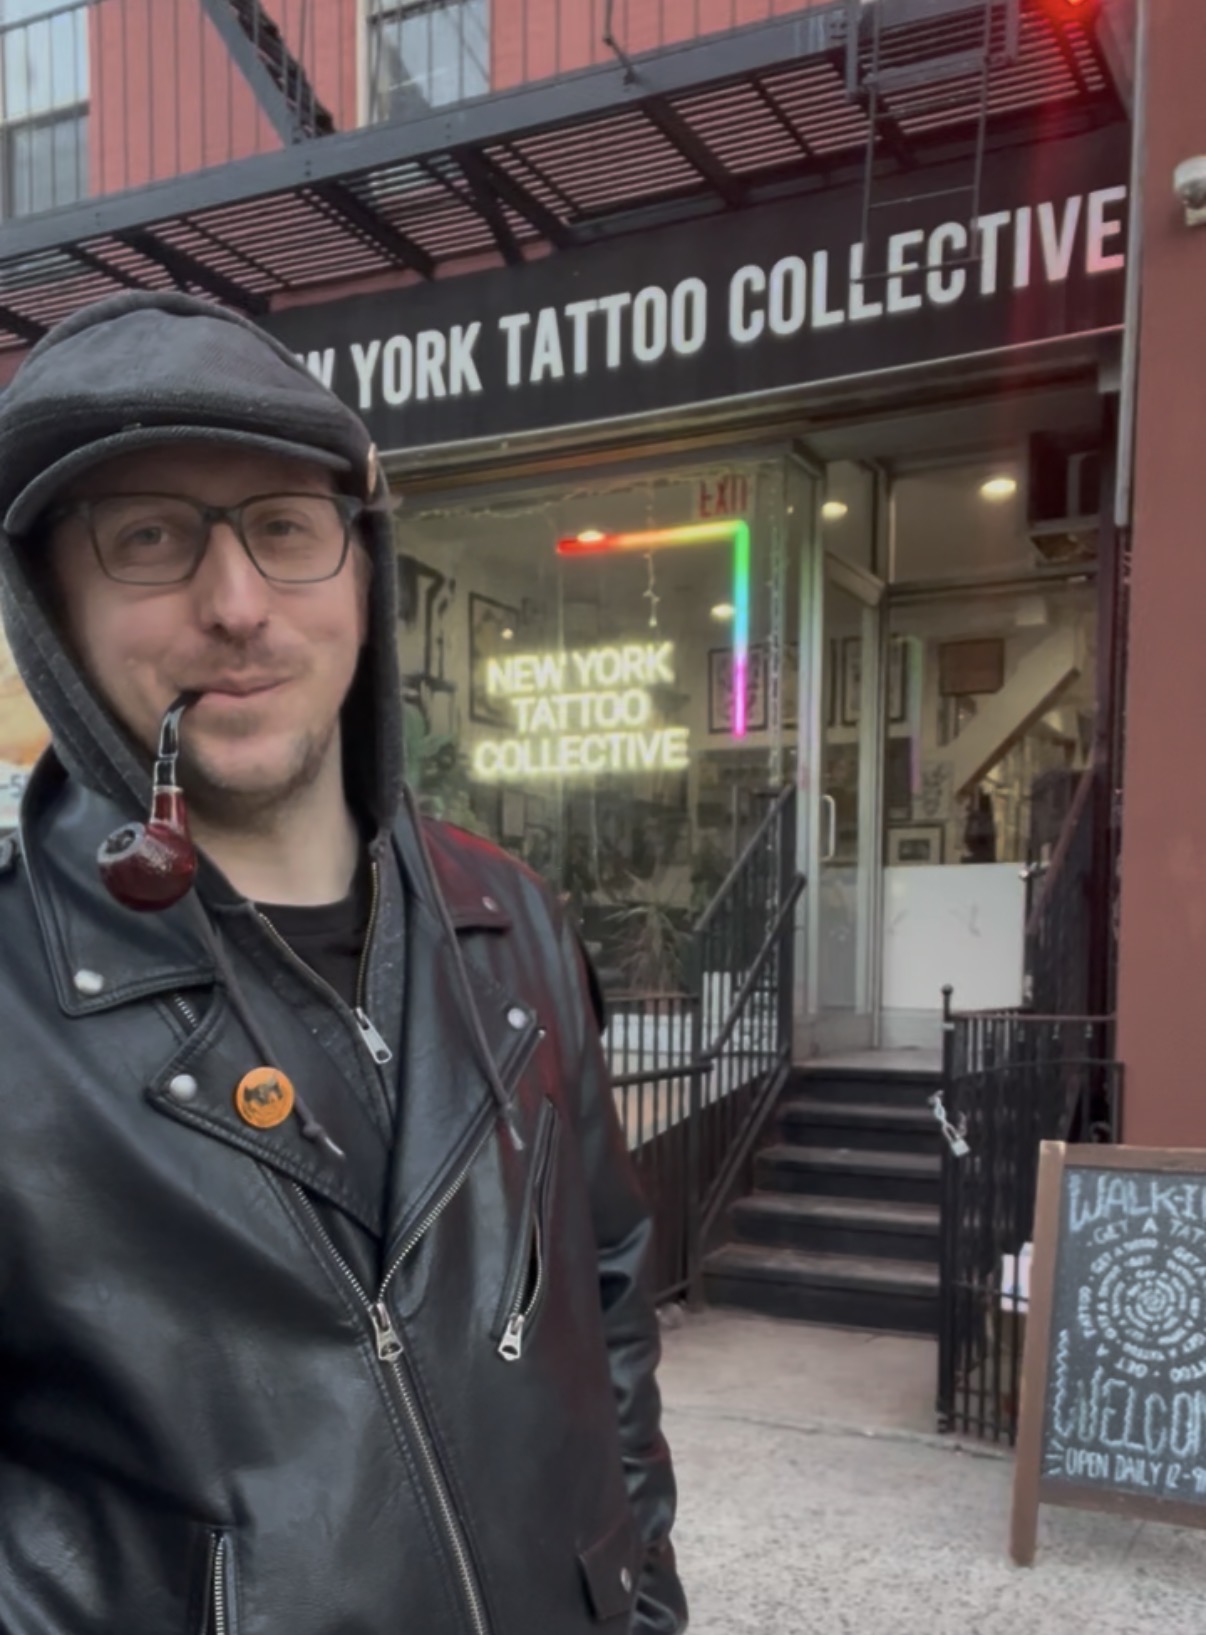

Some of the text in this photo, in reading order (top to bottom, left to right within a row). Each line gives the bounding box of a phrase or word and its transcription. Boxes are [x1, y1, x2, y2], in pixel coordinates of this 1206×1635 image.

[350, 186, 1125, 409] YORK TATTOO COLLECTIVE
[486, 642, 674, 693] NEW YORK
[512, 689, 650, 733] TATTOO
[474, 728, 690, 778] COLLECTIVE
[1066, 1447, 1109, 1478] OPEN
[1115, 1453, 1162, 1486] DAILY
